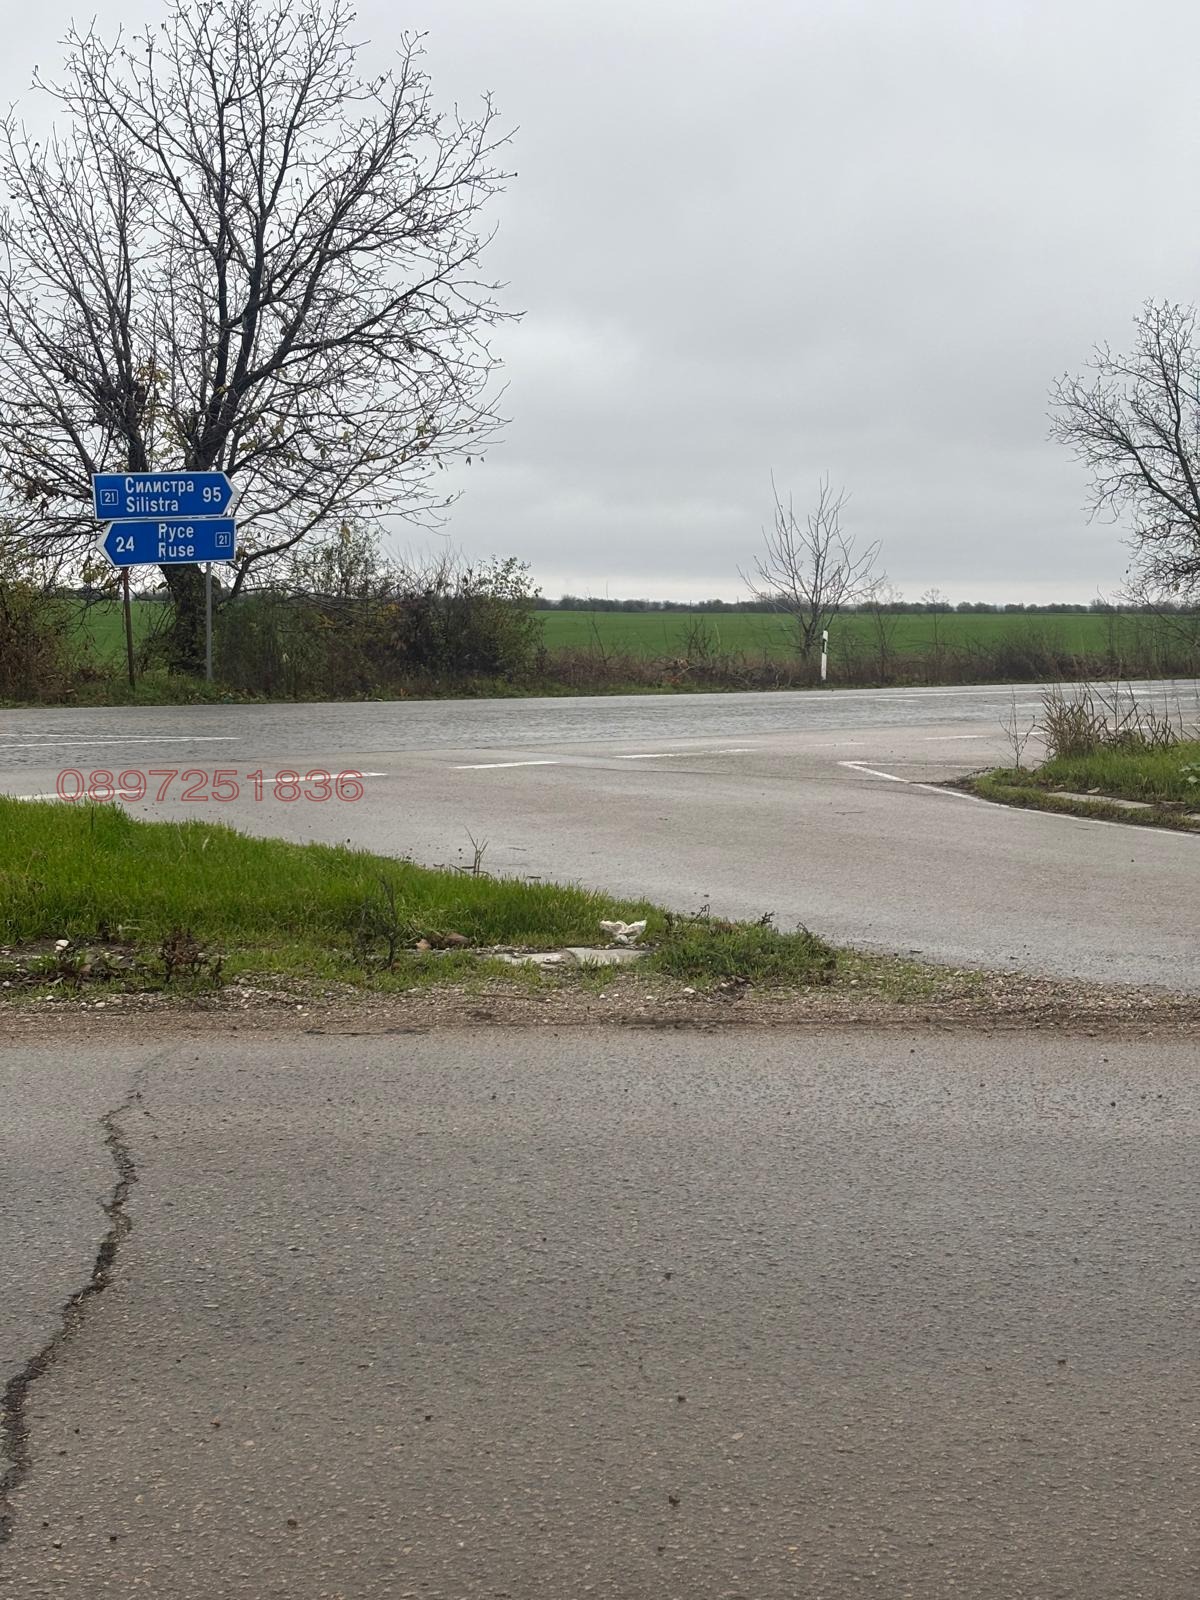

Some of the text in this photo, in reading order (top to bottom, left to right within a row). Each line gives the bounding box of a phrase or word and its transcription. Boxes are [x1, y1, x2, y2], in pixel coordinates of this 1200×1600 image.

[125, 477, 194, 496] Силистра
[203, 487, 221, 502] 95
[105, 493, 115, 502] 21
[126, 496, 179, 512] Silistra
[158, 523, 194, 542] Русе
[218, 536, 228, 545] 21
[115, 536, 135, 553] 24
[158, 542, 195, 558] Ruse
